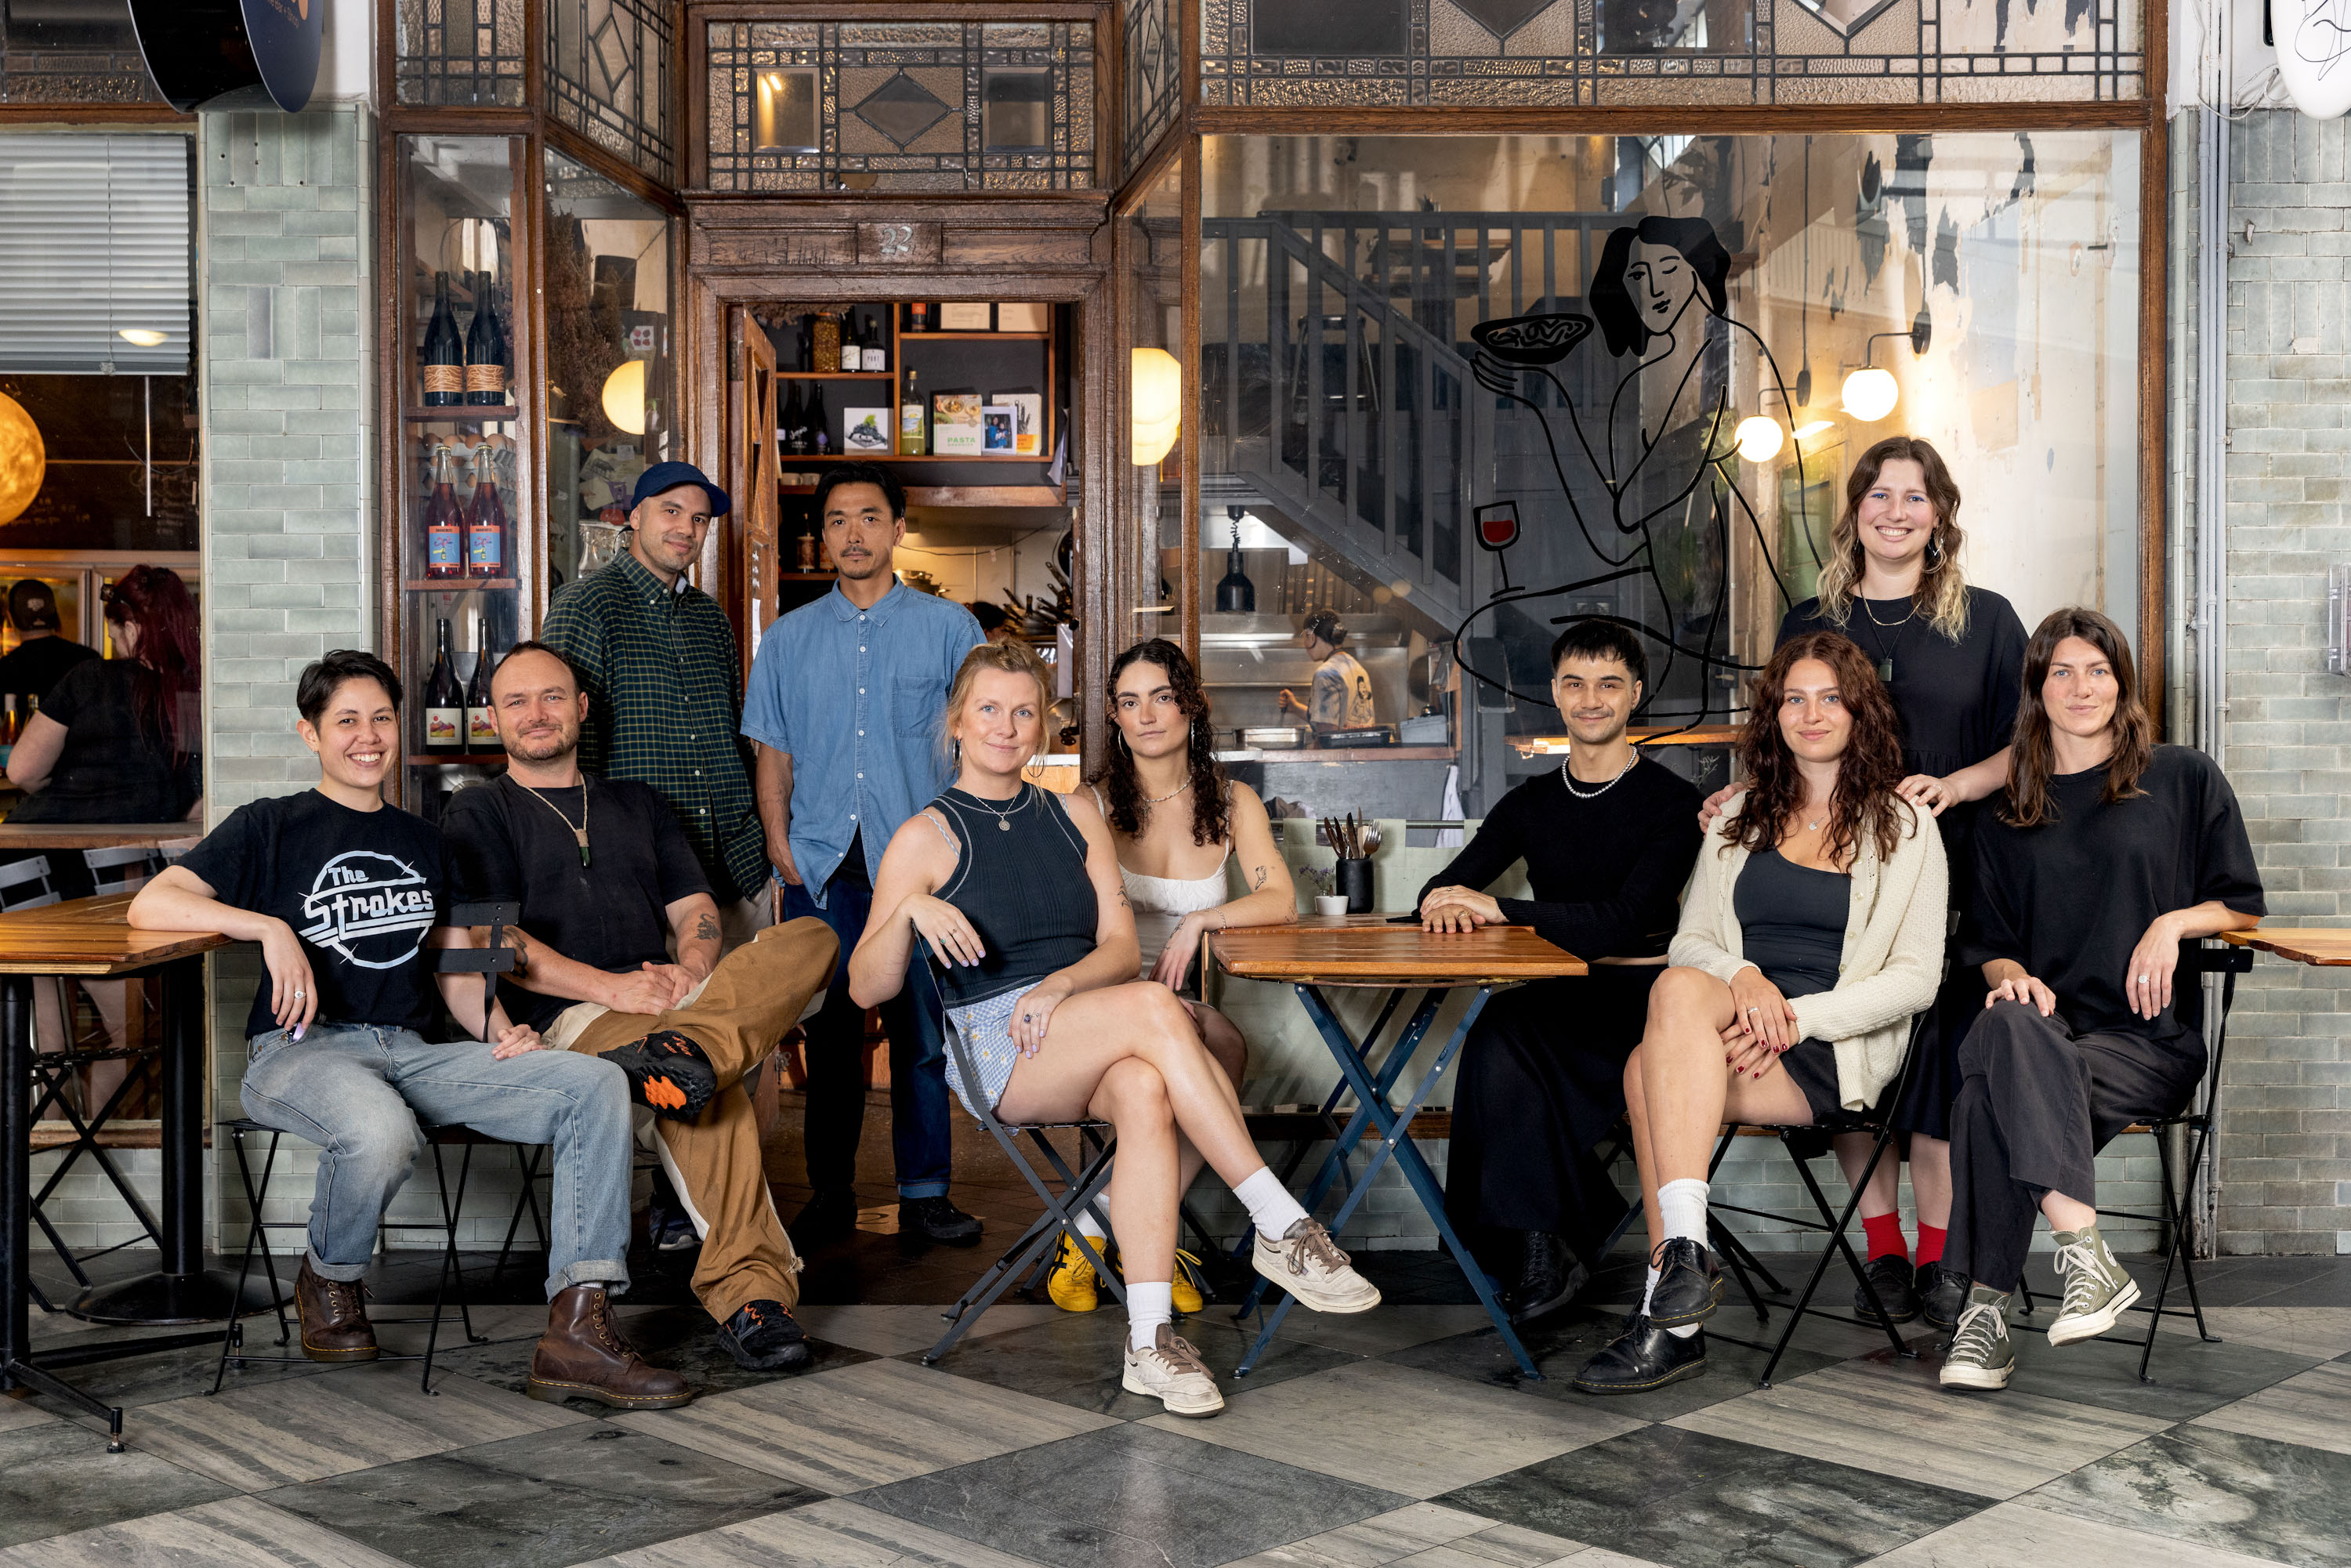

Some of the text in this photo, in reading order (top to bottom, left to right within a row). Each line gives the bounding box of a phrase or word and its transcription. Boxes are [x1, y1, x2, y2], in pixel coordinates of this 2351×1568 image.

[881, 226, 913, 255] 22
[328, 866, 369, 886] The
[299, 888, 434, 940] Strokes
